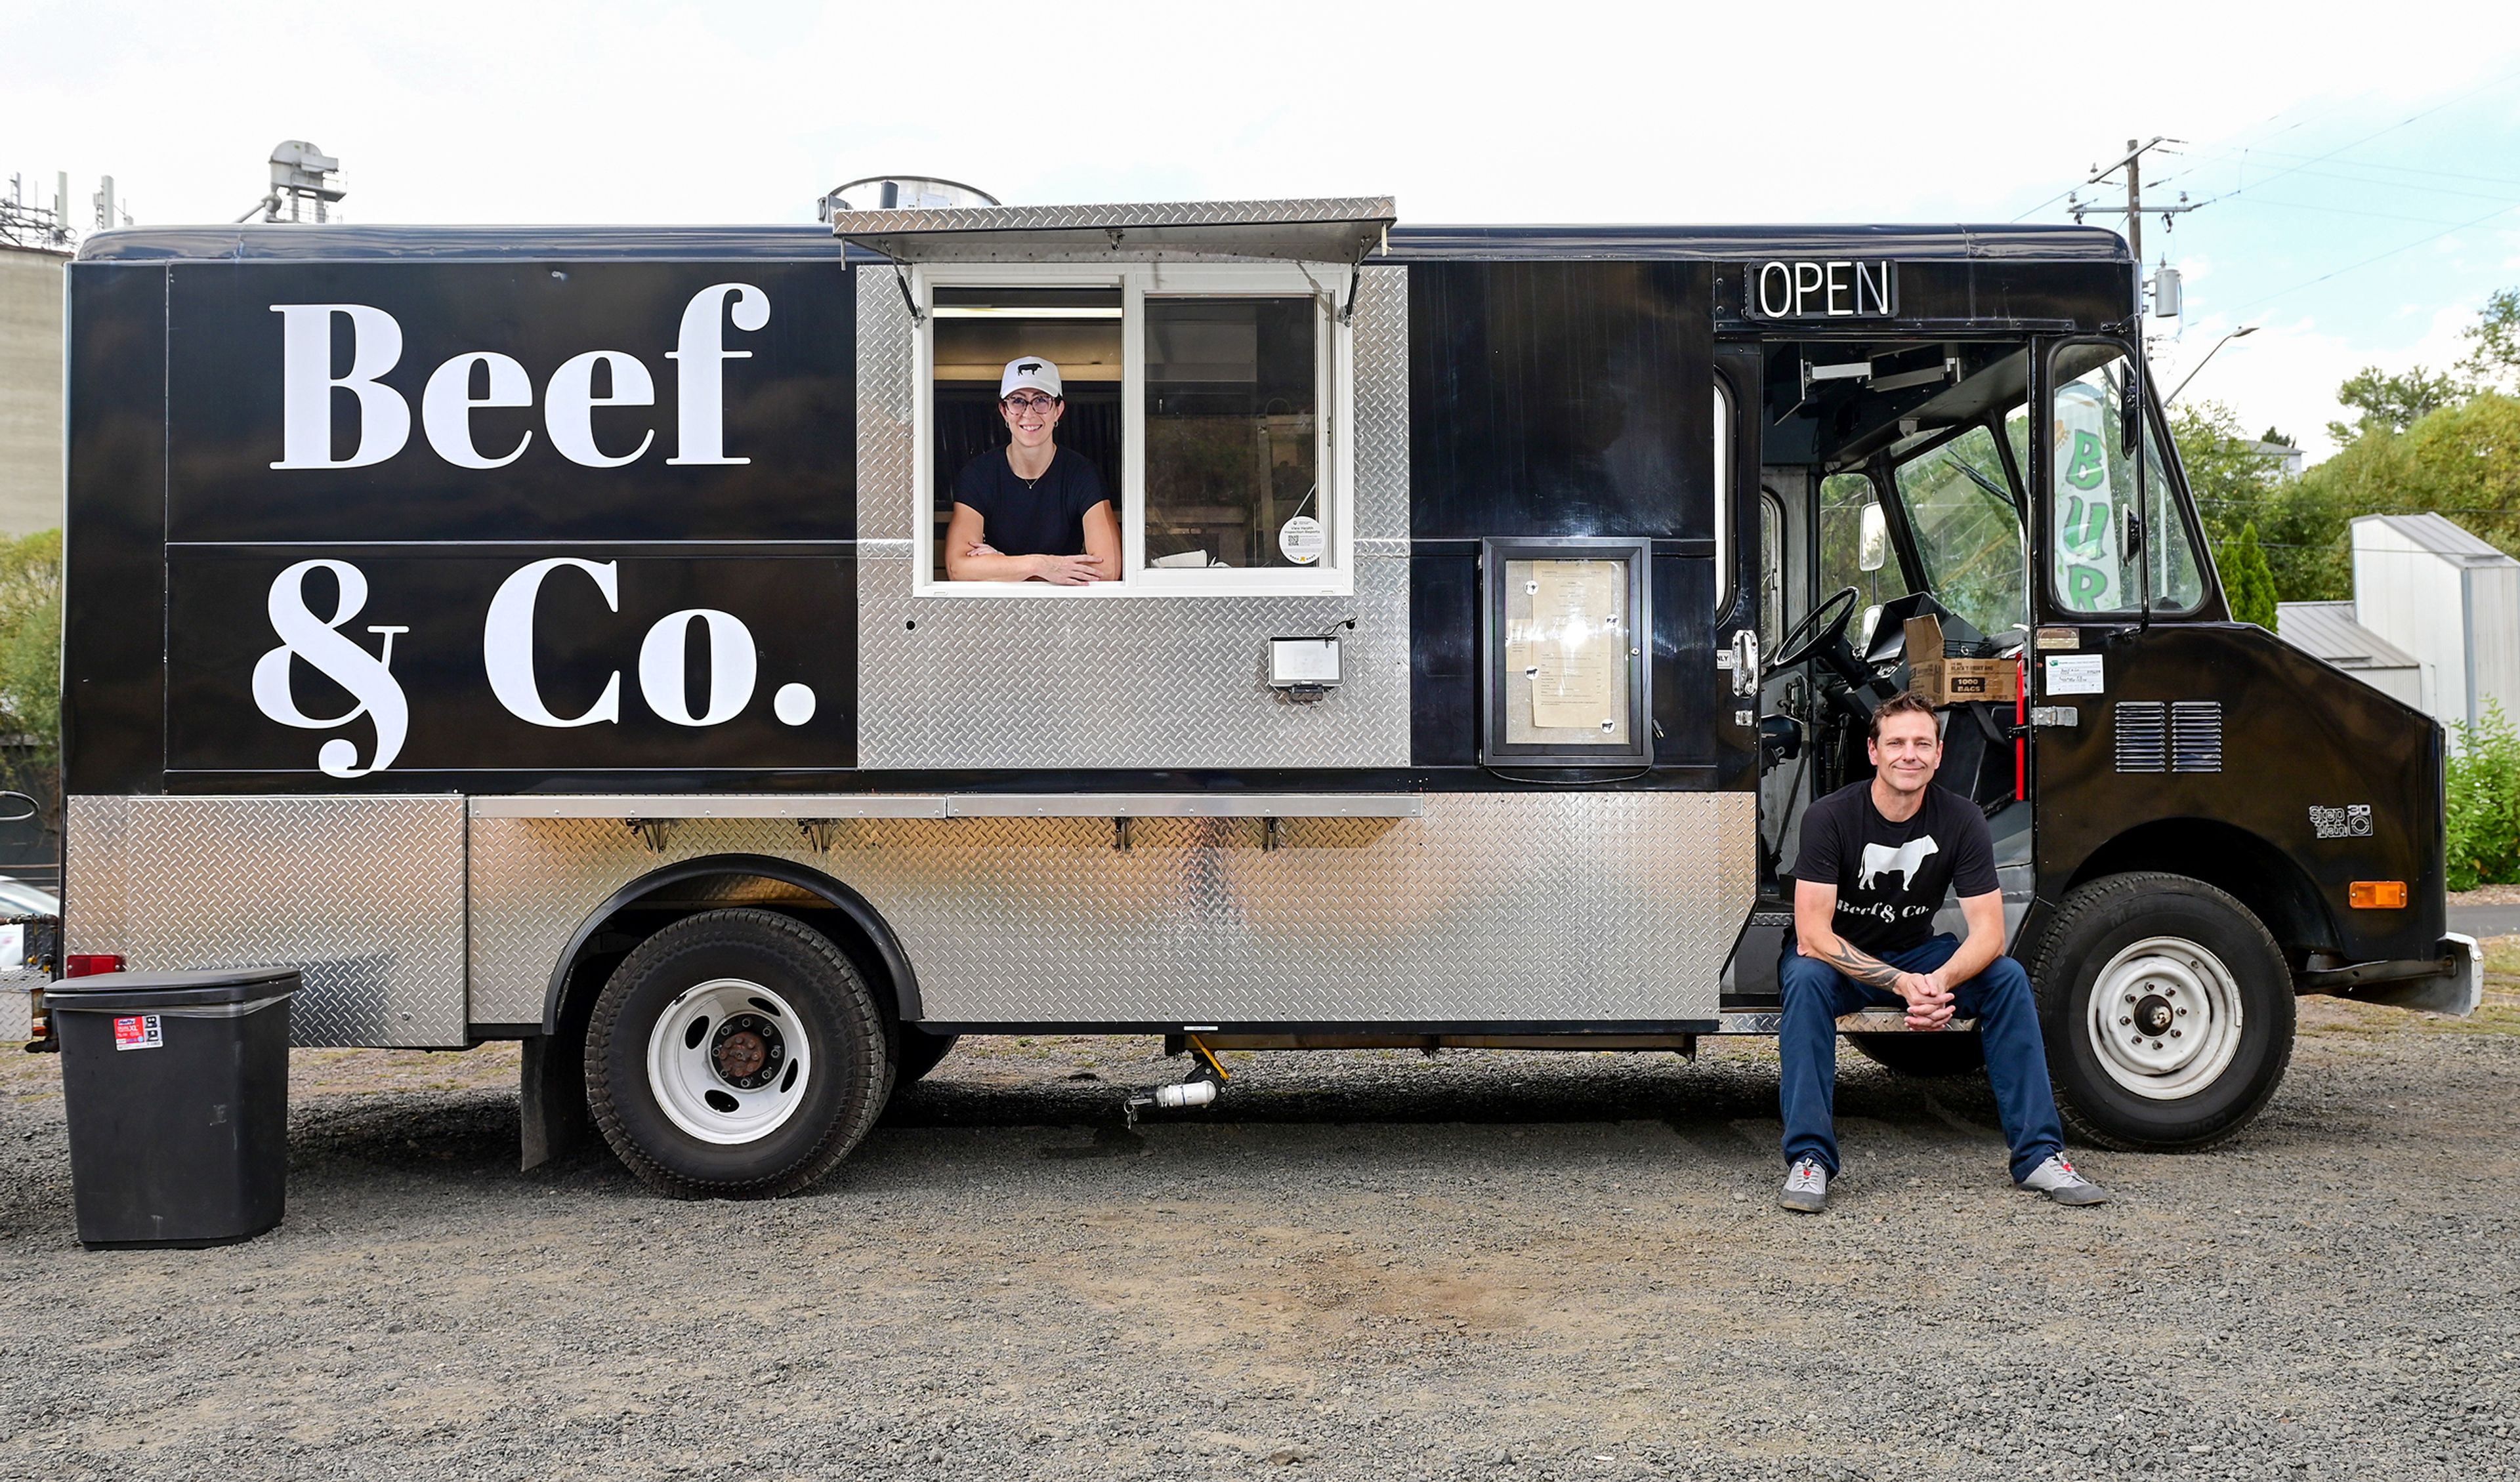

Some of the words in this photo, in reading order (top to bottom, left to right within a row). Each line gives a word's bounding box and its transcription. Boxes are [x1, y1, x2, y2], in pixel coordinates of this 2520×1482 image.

[1759, 260, 1889, 318] OPEN
[269, 282, 770, 470] Beef
[252, 559, 410, 779] &
[484, 558, 816, 728] Co.
[2309, 805, 2345, 823] Step
[2315, 821, 2347, 838] Van
[1837, 899, 1883, 916] Beef
[1880, 905, 1896, 923] &
[1902, 905, 1929, 918] Co.
